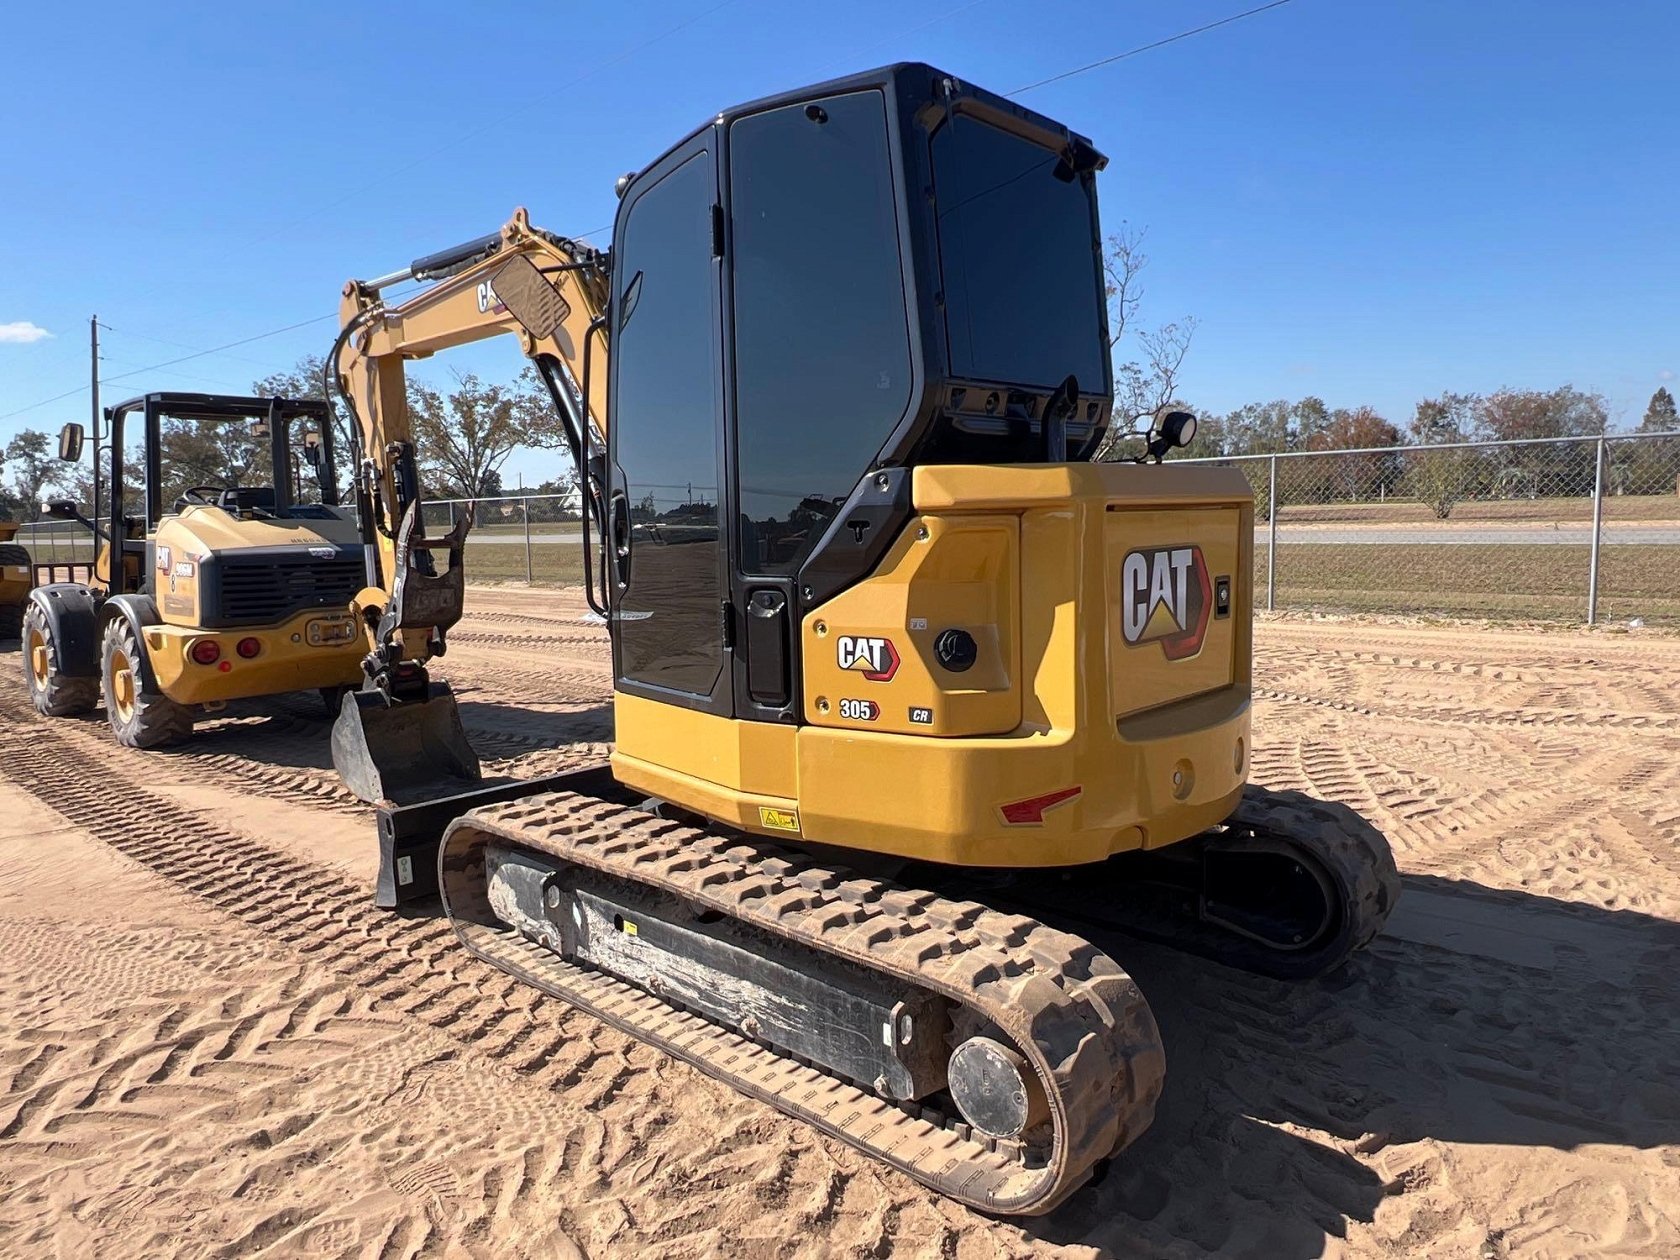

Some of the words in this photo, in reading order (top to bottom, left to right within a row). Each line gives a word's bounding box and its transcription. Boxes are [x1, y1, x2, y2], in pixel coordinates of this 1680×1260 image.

[478, 280, 502, 312] CA
[1123, 549, 1193, 642] CAT
[838, 636, 885, 672] CAT
[840, 699, 871, 719] 305
[912, 709, 928, 721] CR
